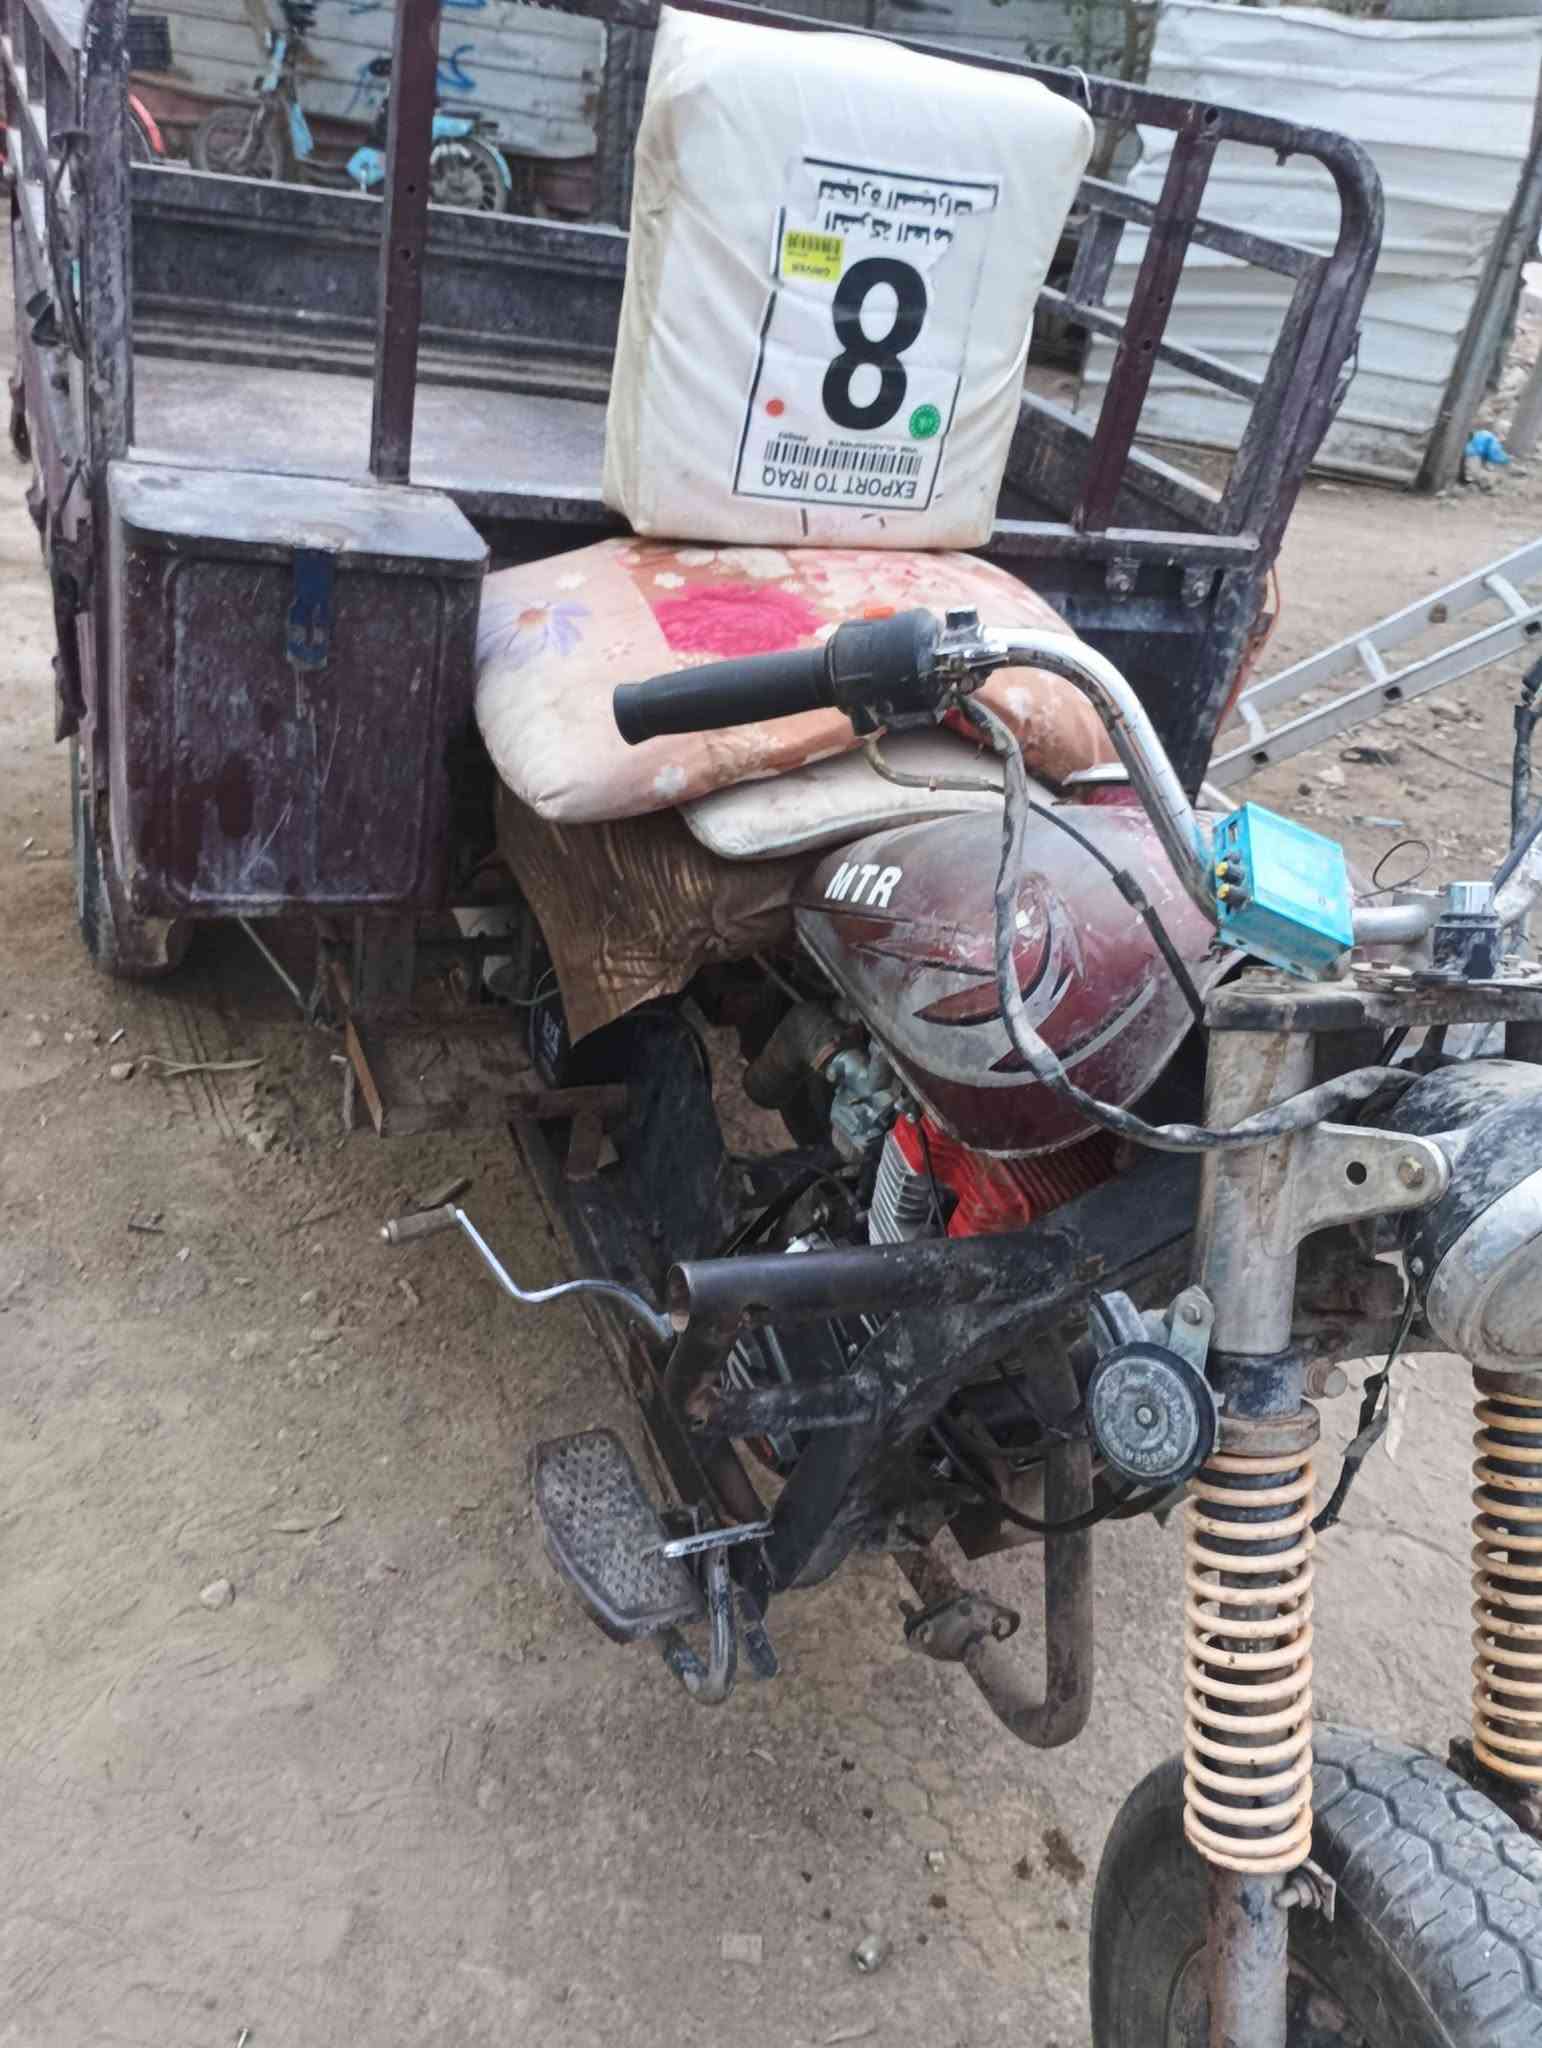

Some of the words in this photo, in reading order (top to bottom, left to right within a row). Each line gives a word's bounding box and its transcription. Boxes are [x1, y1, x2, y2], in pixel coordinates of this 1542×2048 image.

[818, 179, 882, 206] لتجارة
[887, 190, 974, 217] السيارات
[824, 211, 893, 241] الشركة
[822, 257, 928, 431] 8
[761, 464, 811, 491] IRAQ
[813, 471, 838, 494] TO
[842, 475, 918, 500] EXPORT
[824, 862, 904, 909] MTR
